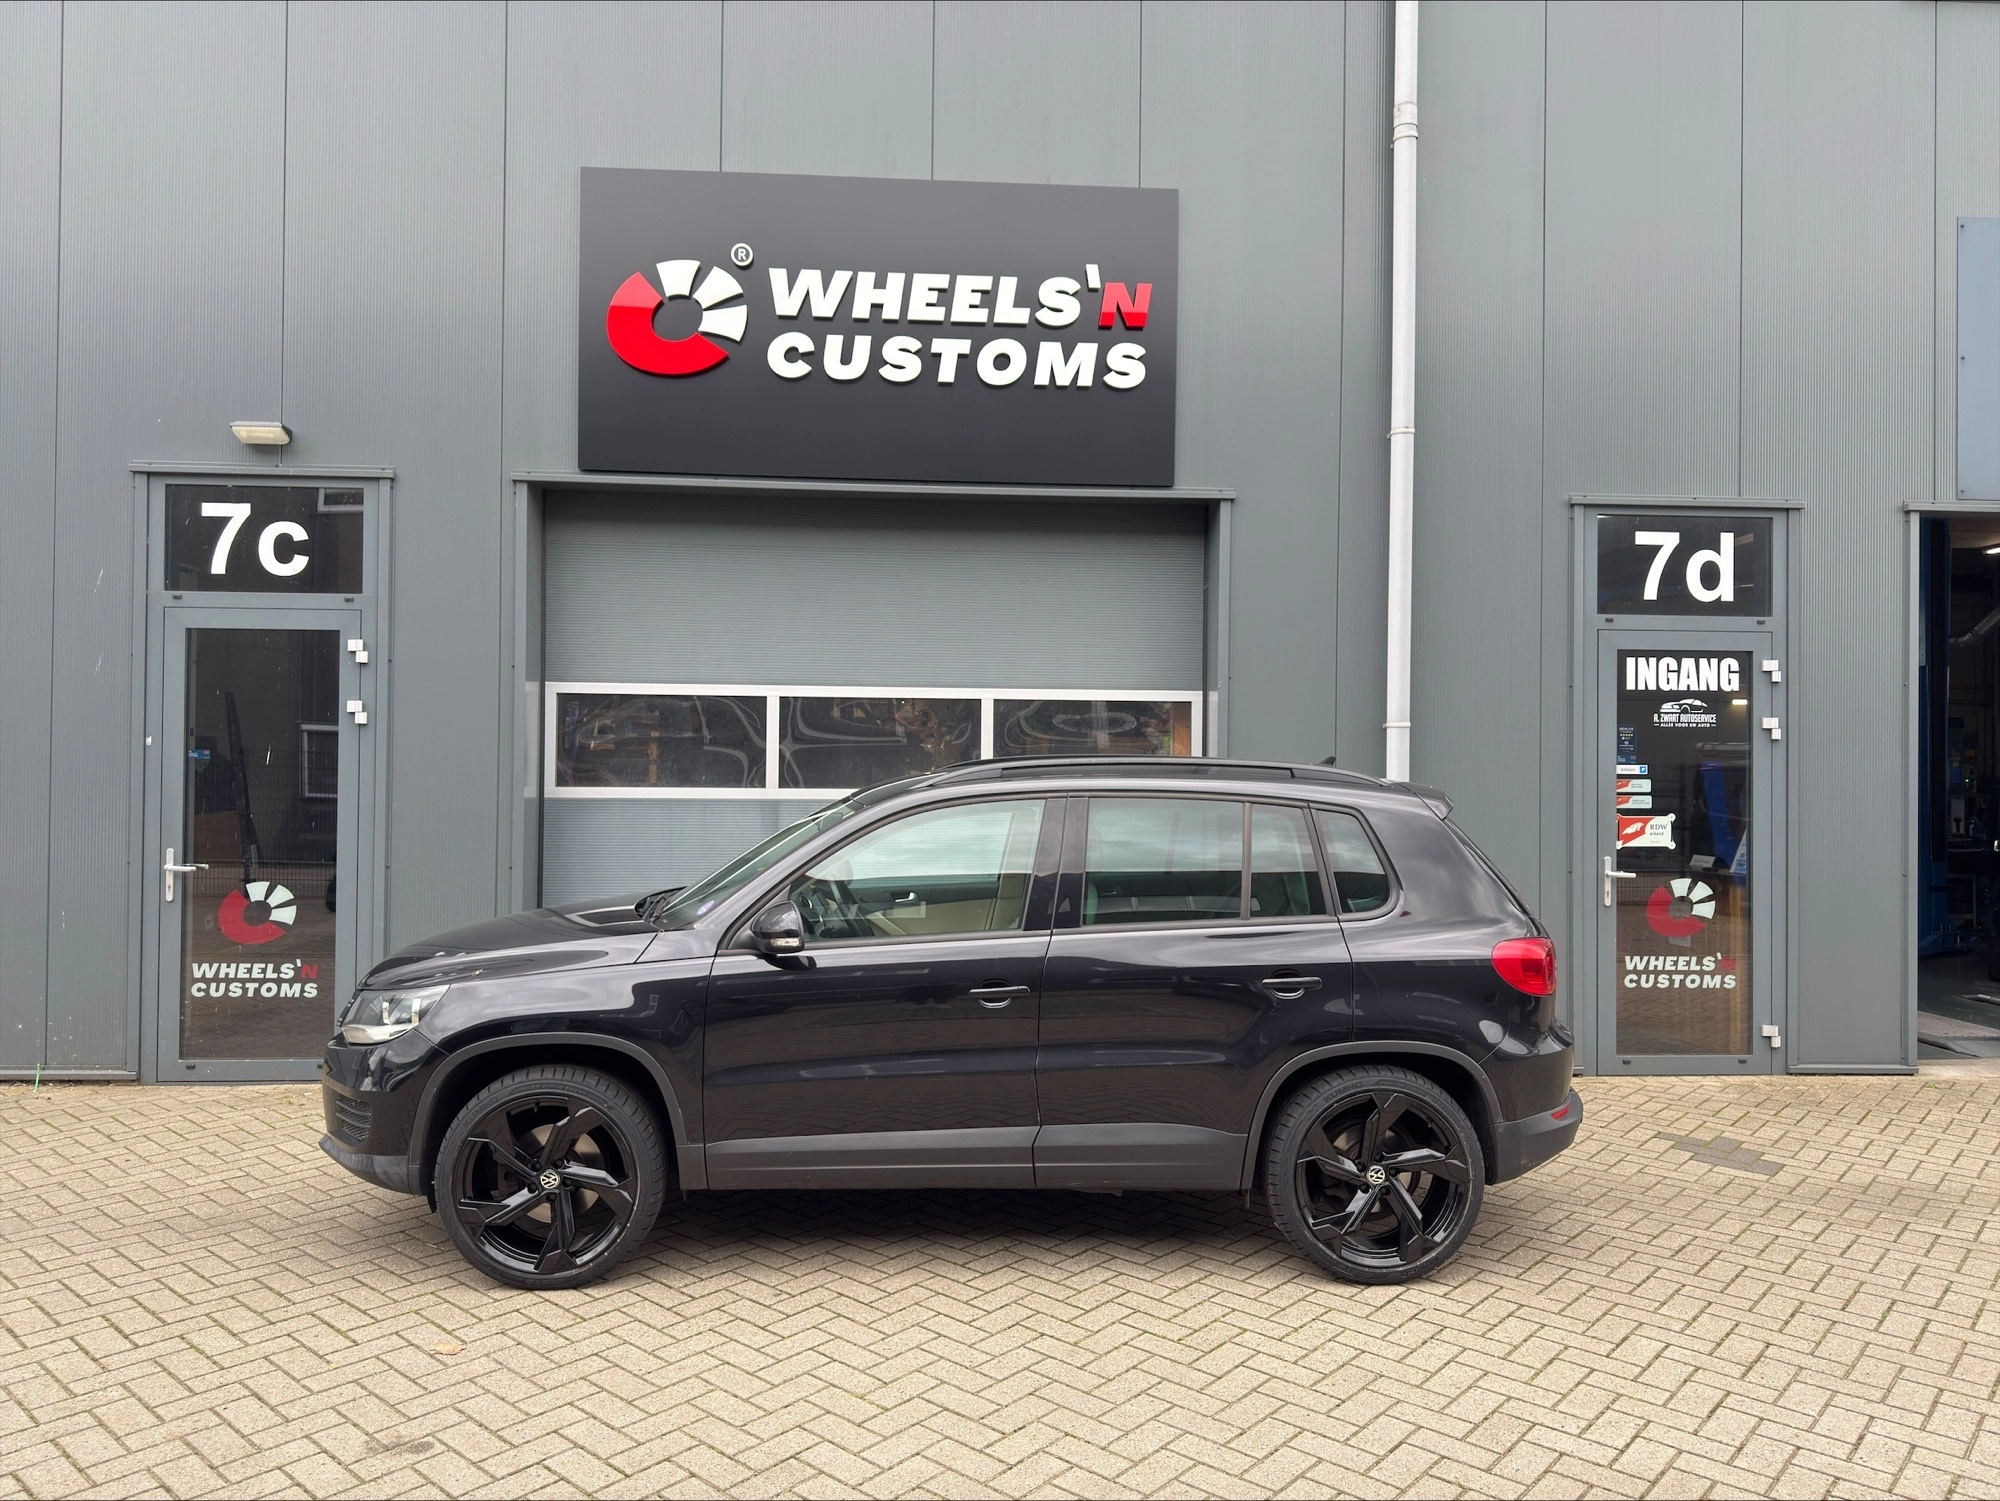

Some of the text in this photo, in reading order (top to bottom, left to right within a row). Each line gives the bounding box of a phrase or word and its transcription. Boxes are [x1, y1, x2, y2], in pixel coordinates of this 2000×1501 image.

[766, 331, 1147, 389] CUSTOMS
[1626, 657, 1740, 692] INGANG
[1660, 714, 1679, 722] ZWART
[1680, 714, 1716, 722] AUTOSERVICE
[1623, 974, 1737, 989] CUSTOMS
[190, 982, 318, 998] CUSTOMS
